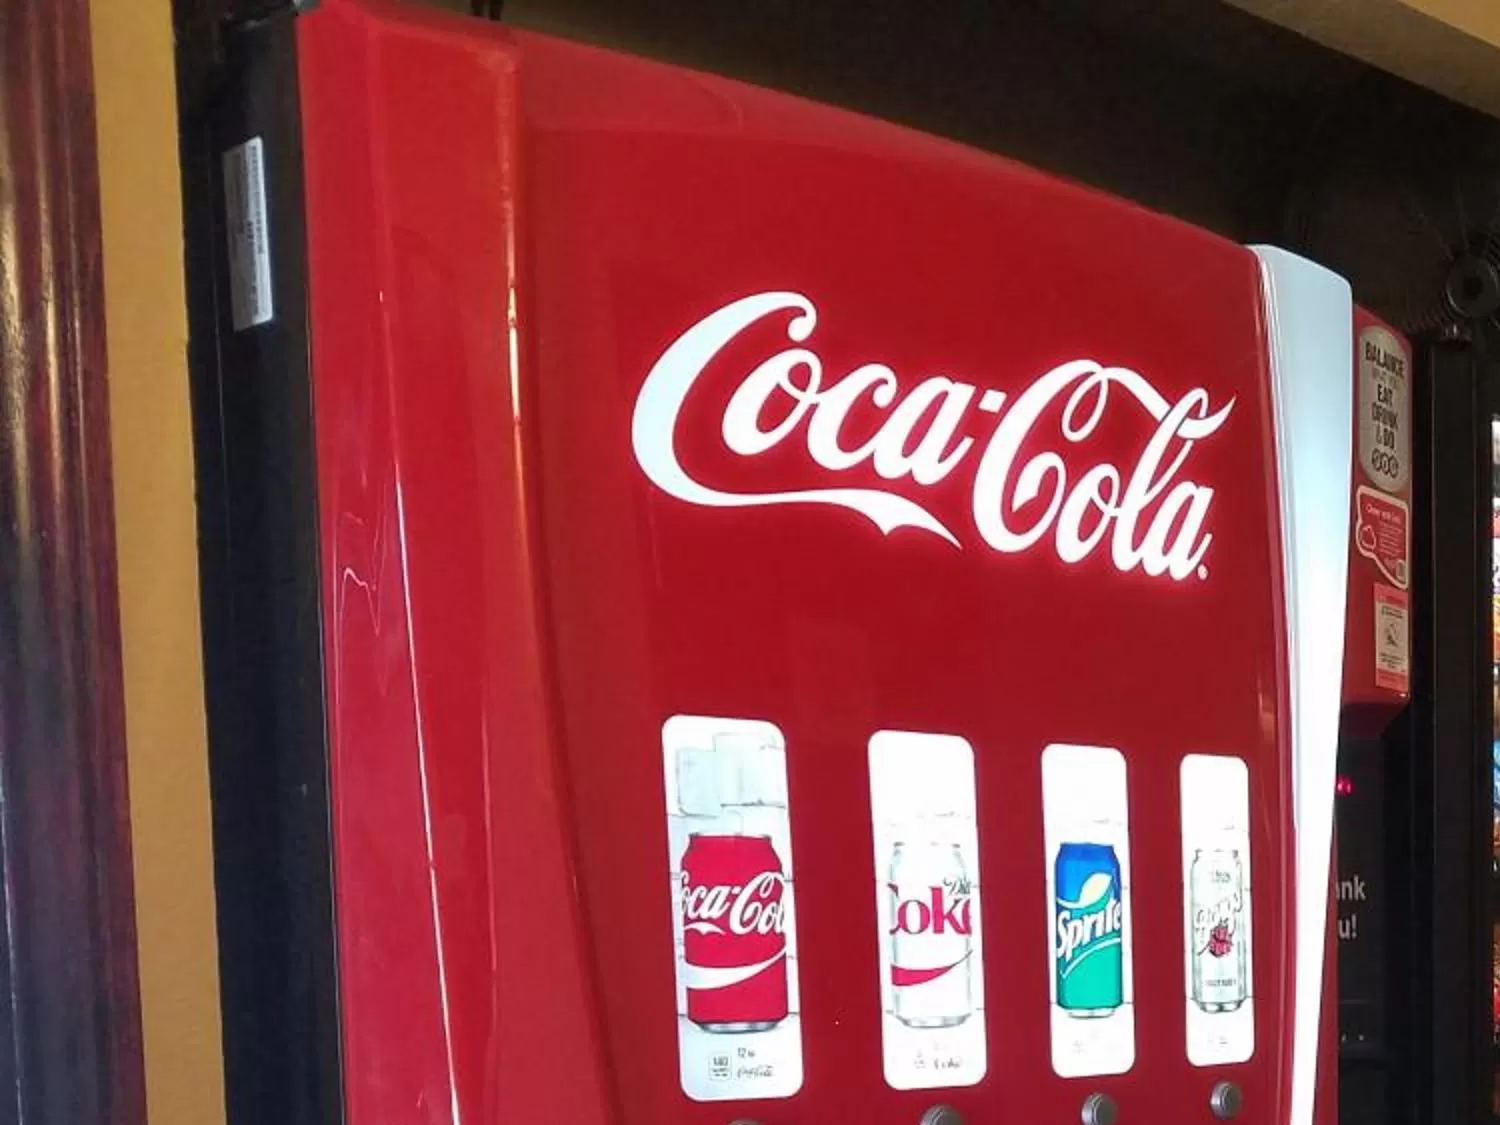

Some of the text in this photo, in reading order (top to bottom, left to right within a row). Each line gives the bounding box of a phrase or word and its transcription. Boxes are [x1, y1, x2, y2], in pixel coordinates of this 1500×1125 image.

[631, 290, 1237, 581] Coca-Cola
[680, 870, 786, 936] oca-Col
[1057, 899, 1121, 963] Sprite
